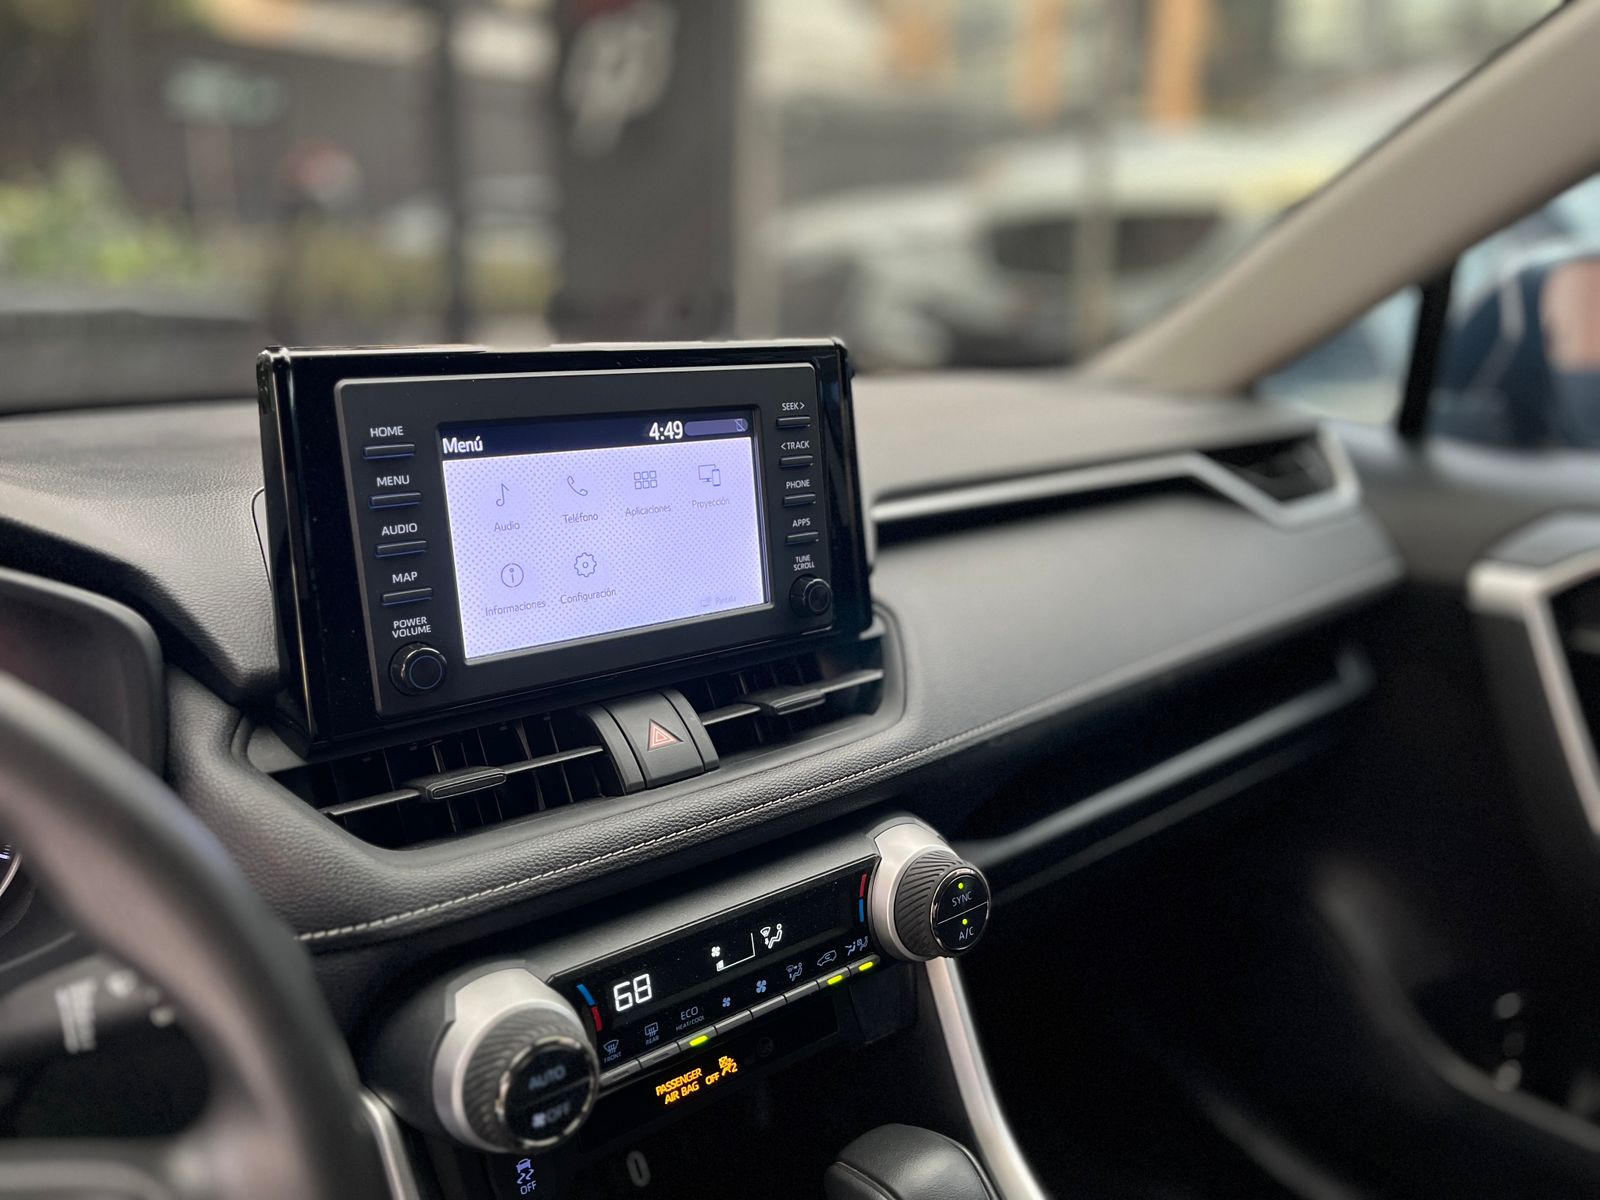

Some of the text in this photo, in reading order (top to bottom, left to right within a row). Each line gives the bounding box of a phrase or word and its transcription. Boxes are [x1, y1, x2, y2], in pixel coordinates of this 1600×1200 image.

[782, 402, 799, 411] SEEK
[370, 426, 404, 437] HOME
[649, 420, 684, 441] 4:49
[442, 436, 484, 454] Menú
[787, 440, 810, 450] TRACK
[376, 475, 410, 487] MENU
[786, 479, 810, 489] PHONE
[562, 512, 599, 524] Teléfono
[625, 504, 672, 518] Aplicaciones
[381, 523, 418, 536] AUDIO
[494, 521, 520, 532] Audio
[792, 518, 811, 528] APPS
[795, 554, 811, 563] TUNE
[793, 561, 815, 571] SCROLL
[392, 571, 418, 583] MAP
[560, 588, 617, 605] Configuración
[485, 600, 546, 617] Informaciones
[393, 616, 428, 629] POWER
[391, 625, 432, 639] VOLUME
[951, 891, 972, 907] SYNC
[958, 926, 974, 941] A/C
[613, 973, 653, 1012] 68
[680, 1006, 699, 1021] ECO
[528, 1064, 567, 1091] AUTO
[656, 1068, 703, 1096] PASSENGER
[664, 1072, 720, 1105] AIR BAG OFF
[520, 1181, 537, 1195] OFF
